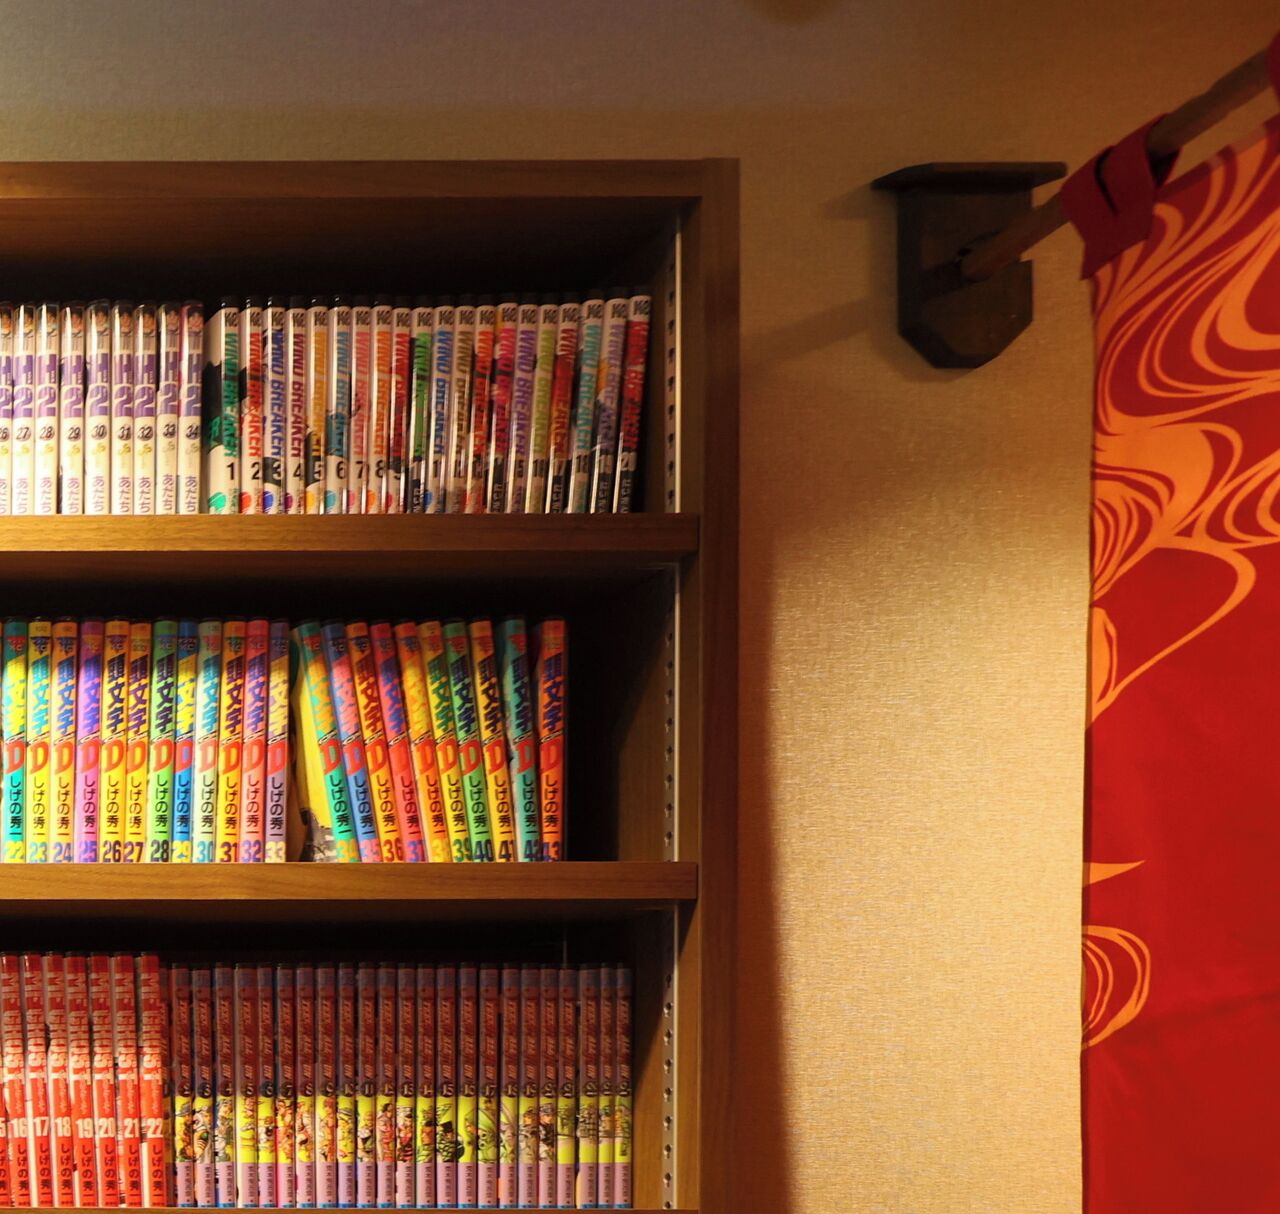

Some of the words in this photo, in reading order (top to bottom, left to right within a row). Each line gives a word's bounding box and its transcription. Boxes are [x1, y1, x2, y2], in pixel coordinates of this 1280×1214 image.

[139, 426, 151, 439] 32
[227, 464, 234, 479] 1
[252, 464, 260, 479] 2
[294, 464, 301, 479] 4
[337, 464, 345, 479] 6
[155, 775, 168, 833] しげの秀一
[104, 841, 121, 861] 26
[152, 840, 169, 861] 28
[221, 841, 239, 861] 31
[241, 841, 263, 861] 32
[97, 1118, 114, 1138] 20
[147, 1118, 163, 1138] 22
